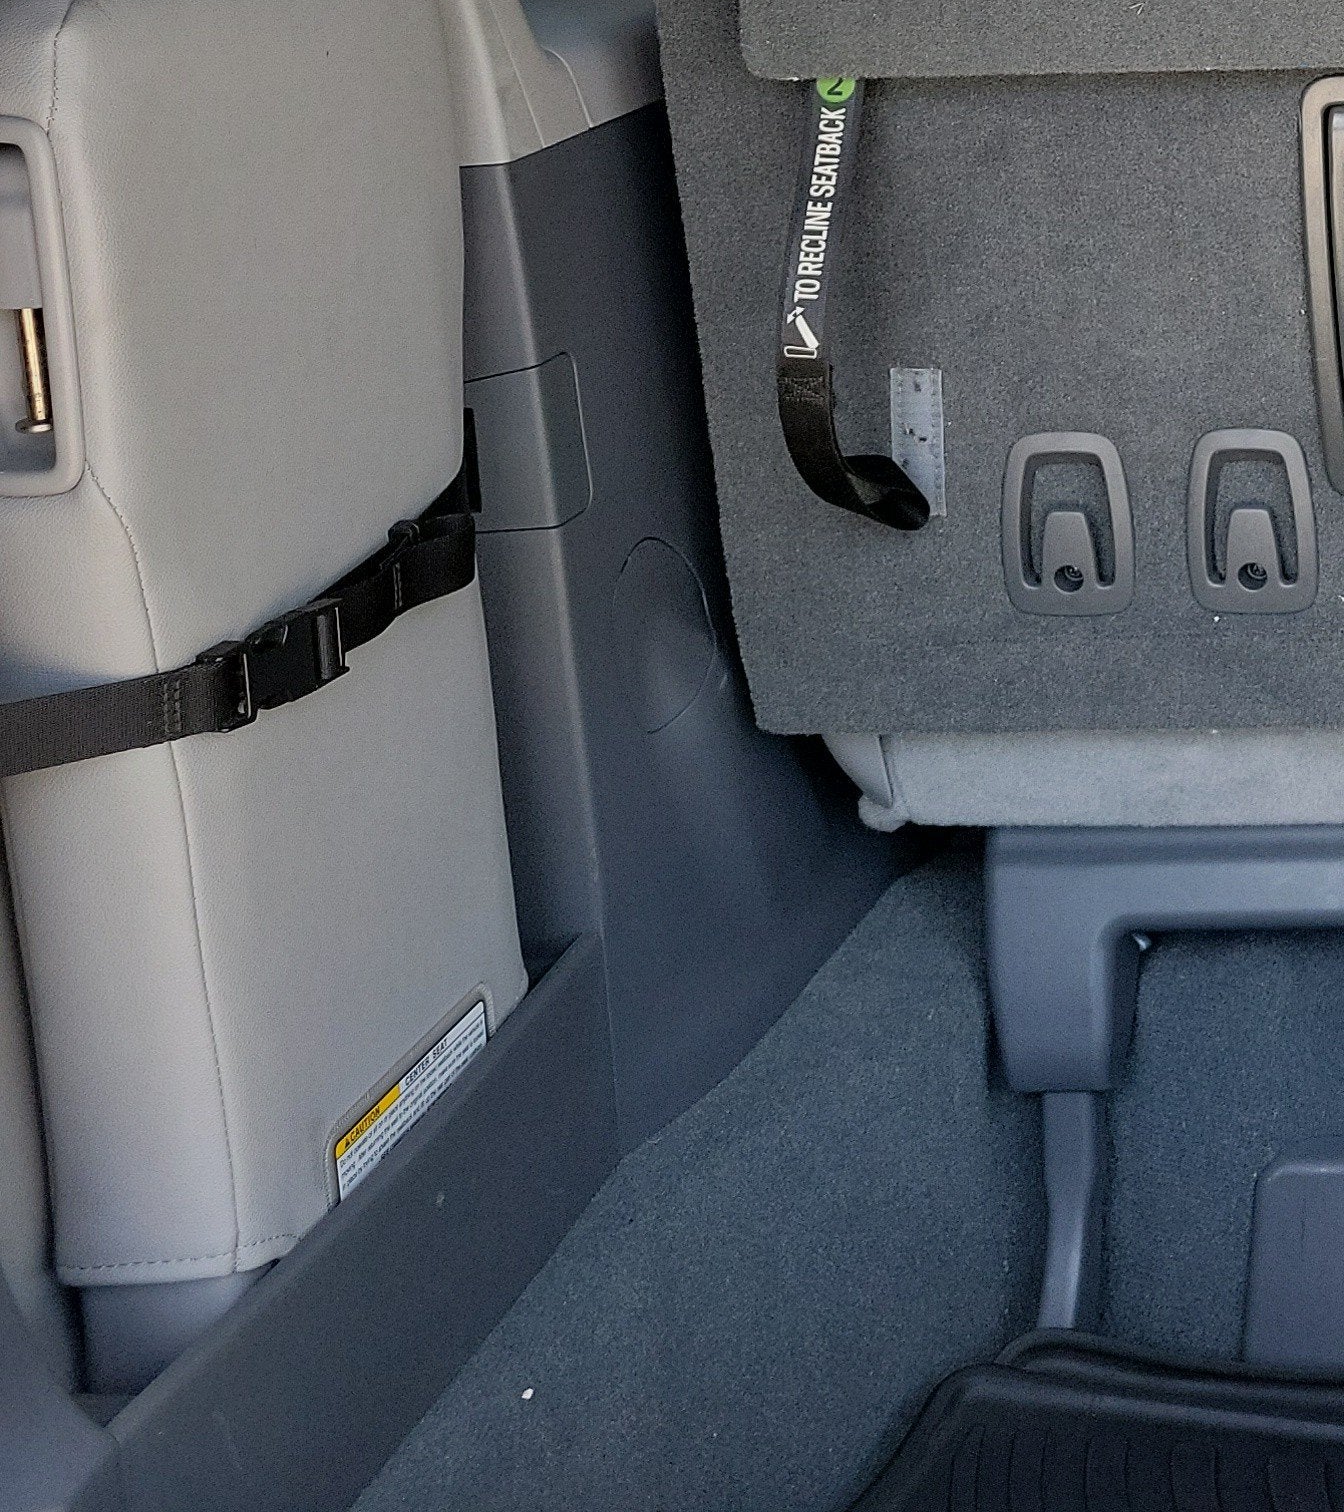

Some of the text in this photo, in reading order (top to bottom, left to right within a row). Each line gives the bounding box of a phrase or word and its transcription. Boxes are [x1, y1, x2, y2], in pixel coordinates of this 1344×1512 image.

[794, 107, 846, 303] TO RECLINE SEATBACK
[404, 1040, 448, 1086] CENTER SEAT
[350, 1106, 380, 1142] CAUTION
